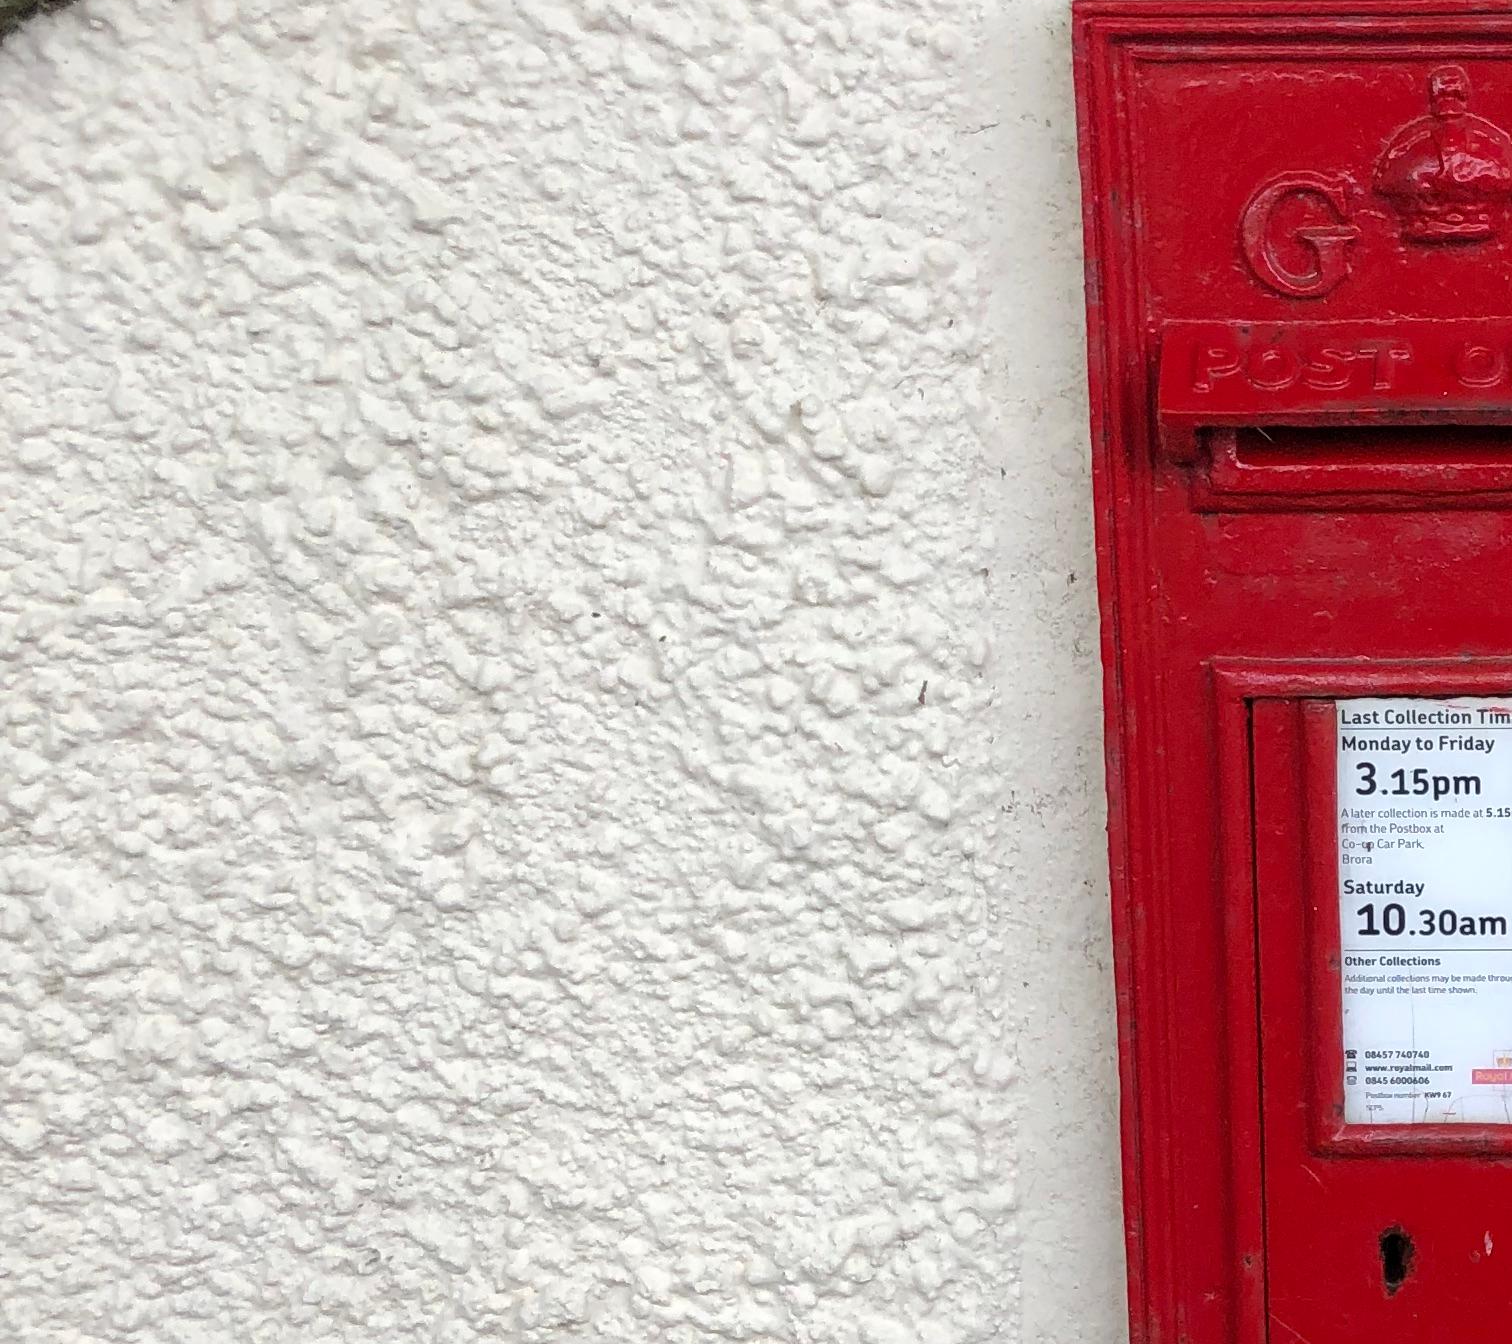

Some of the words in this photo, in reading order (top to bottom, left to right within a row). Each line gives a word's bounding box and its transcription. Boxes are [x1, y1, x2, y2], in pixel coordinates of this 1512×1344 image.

[1240, 170, 1359, 298] G
[1193, 340, 1411, 393] POST
[1341, 710, 1379, 724] Last
[1384, 709, 1472, 724] Collection
[1342, 736, 1411, 754] Monday
[1416, 738, 1433, 751] to
[1439, 736, 1494, 754] Friday
[1355, 762, 1481, 801] 3.15pm
[1341, 809, 1349, 818] A
[1351, 809, 1375, 818] later
[1378, 808, 1427, 818] collection
[1430, 809, 1438, 818] is
[1441, 808, 1470, 818] made
[1473, 809, 1483, 818] at
[1341, 824, 1367, 833] from
[1370, 824, 1387, 834] the
[1390, 823, 1432, 834] Postbox
[1434, 825, 1444, 834] at
[1377, 839, 1395, 848] Car
[1342, 854, 1372, 865] Brora
[1343, 880, 1424, 897] Saturday
[1357, 903, 1507, 936] 10.30am
[1345, 957, 1376, 966] Other
[1379, 956, 1441, 966] Collections
[1345, 974, 1385, 982] Additional
[1387, 974, 1430, 982] collections
[1432, 975, 1449, 985] may
[1451, 974, 1461, 982] be
[1360, 987, 1375, 995] day
[1377, 986, 1395, 994] until
[1397, 986, 1410, 994] the
[1412, 986, 1426, 994] last
[1365, 1064, 1453, 1073] www.royalmail.com
